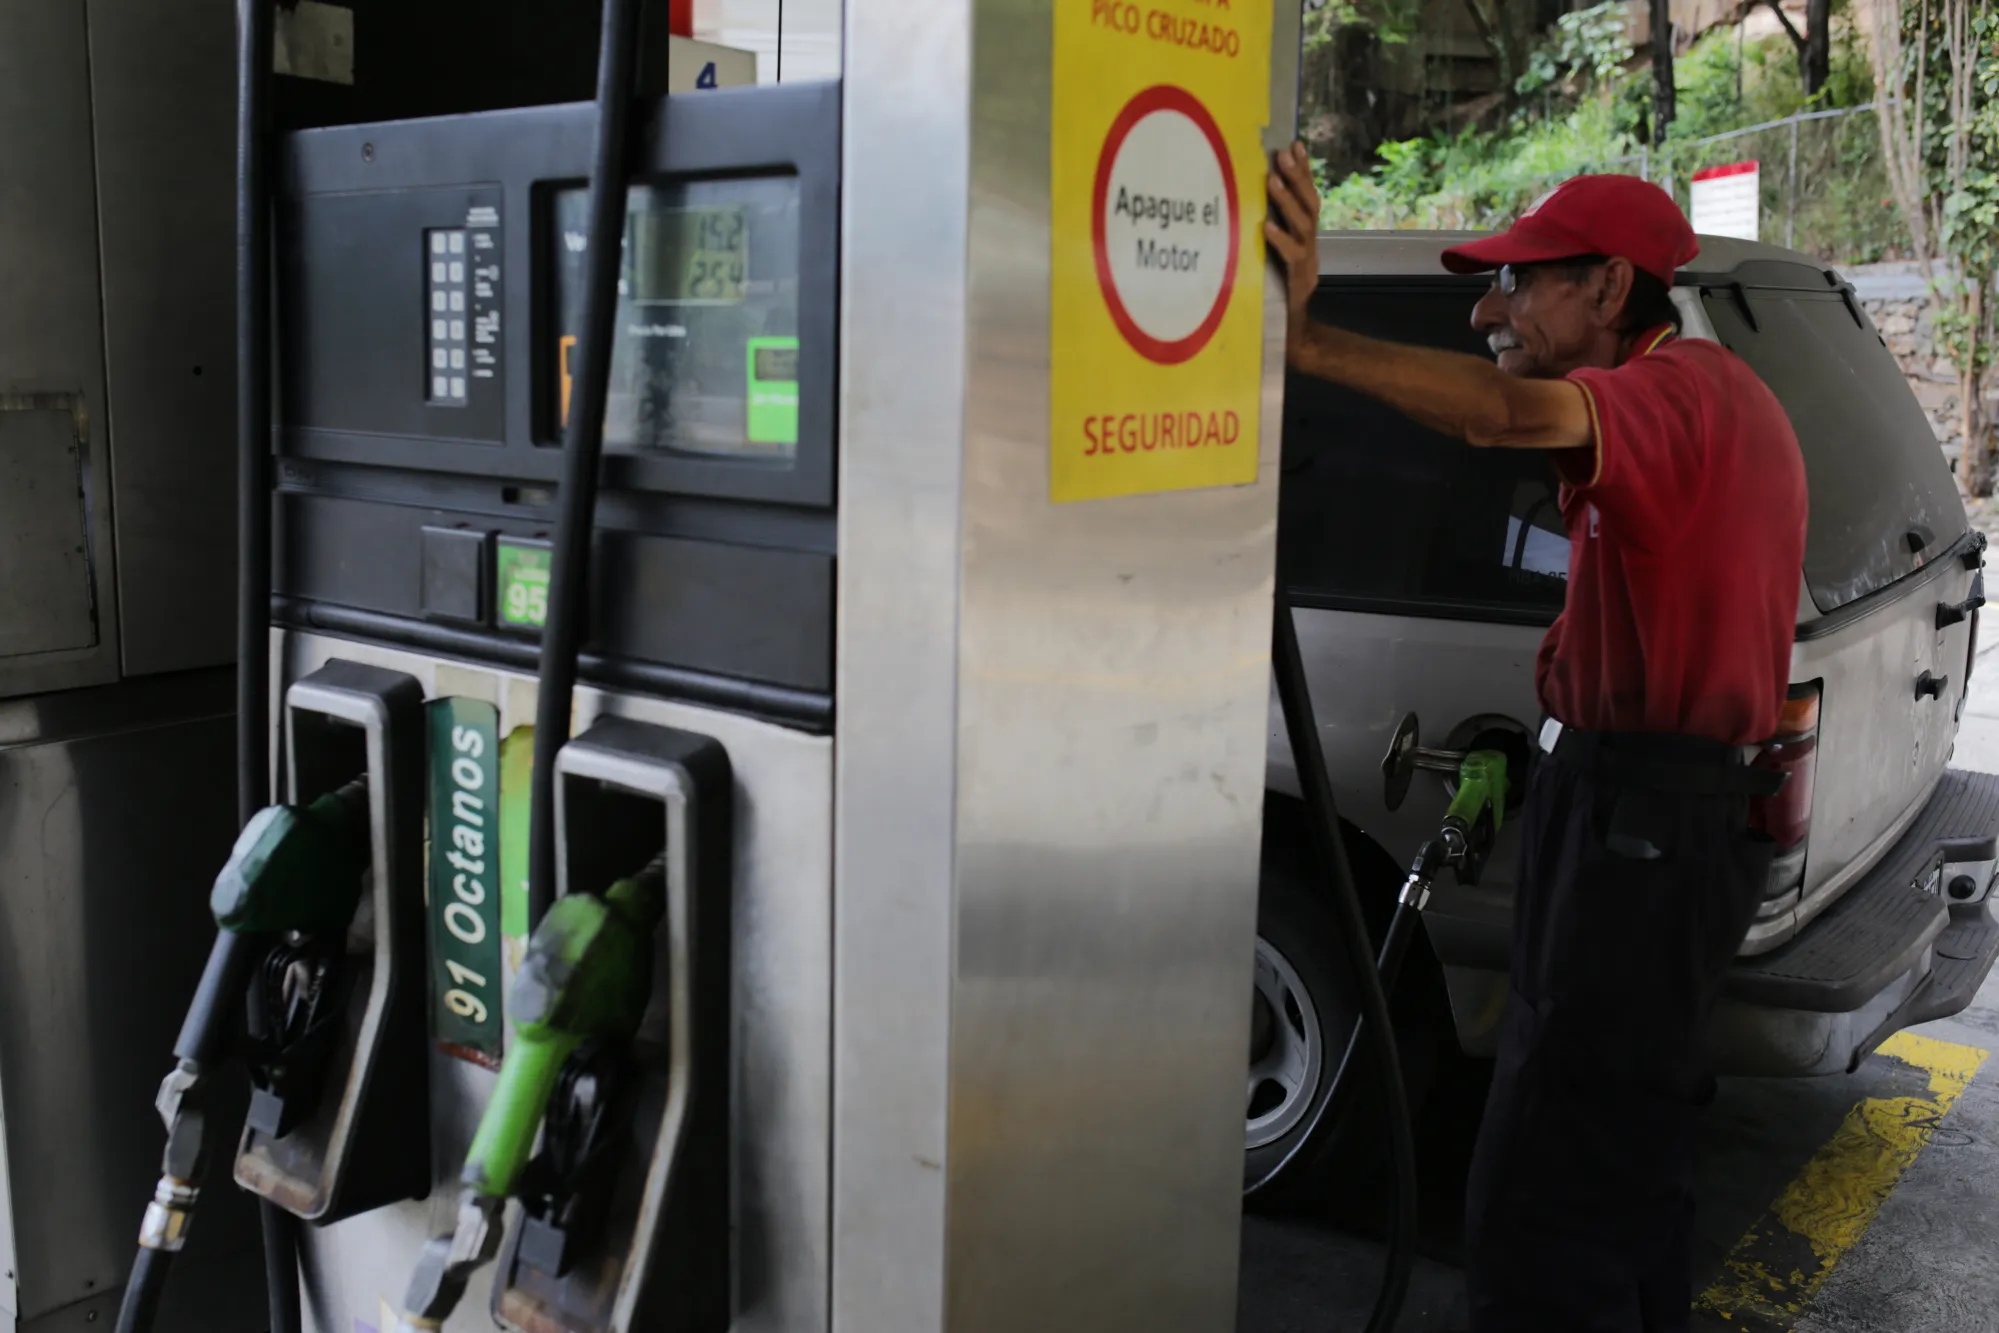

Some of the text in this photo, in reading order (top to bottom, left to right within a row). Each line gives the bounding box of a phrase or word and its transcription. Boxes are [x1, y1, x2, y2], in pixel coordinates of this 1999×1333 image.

[1092, 0, 1240, 58] PICO CRUZADO
[696, 61, 718, 90] 4
[1115, 185, 1220, 231] Apague el
[1136, 239, 1201, 272] Motor
[1083, 410, 1240, 456] SEGURIDAD
[508, 582, 548, 621] 95
[444, 725, 487, 1023] 91 Octanos
